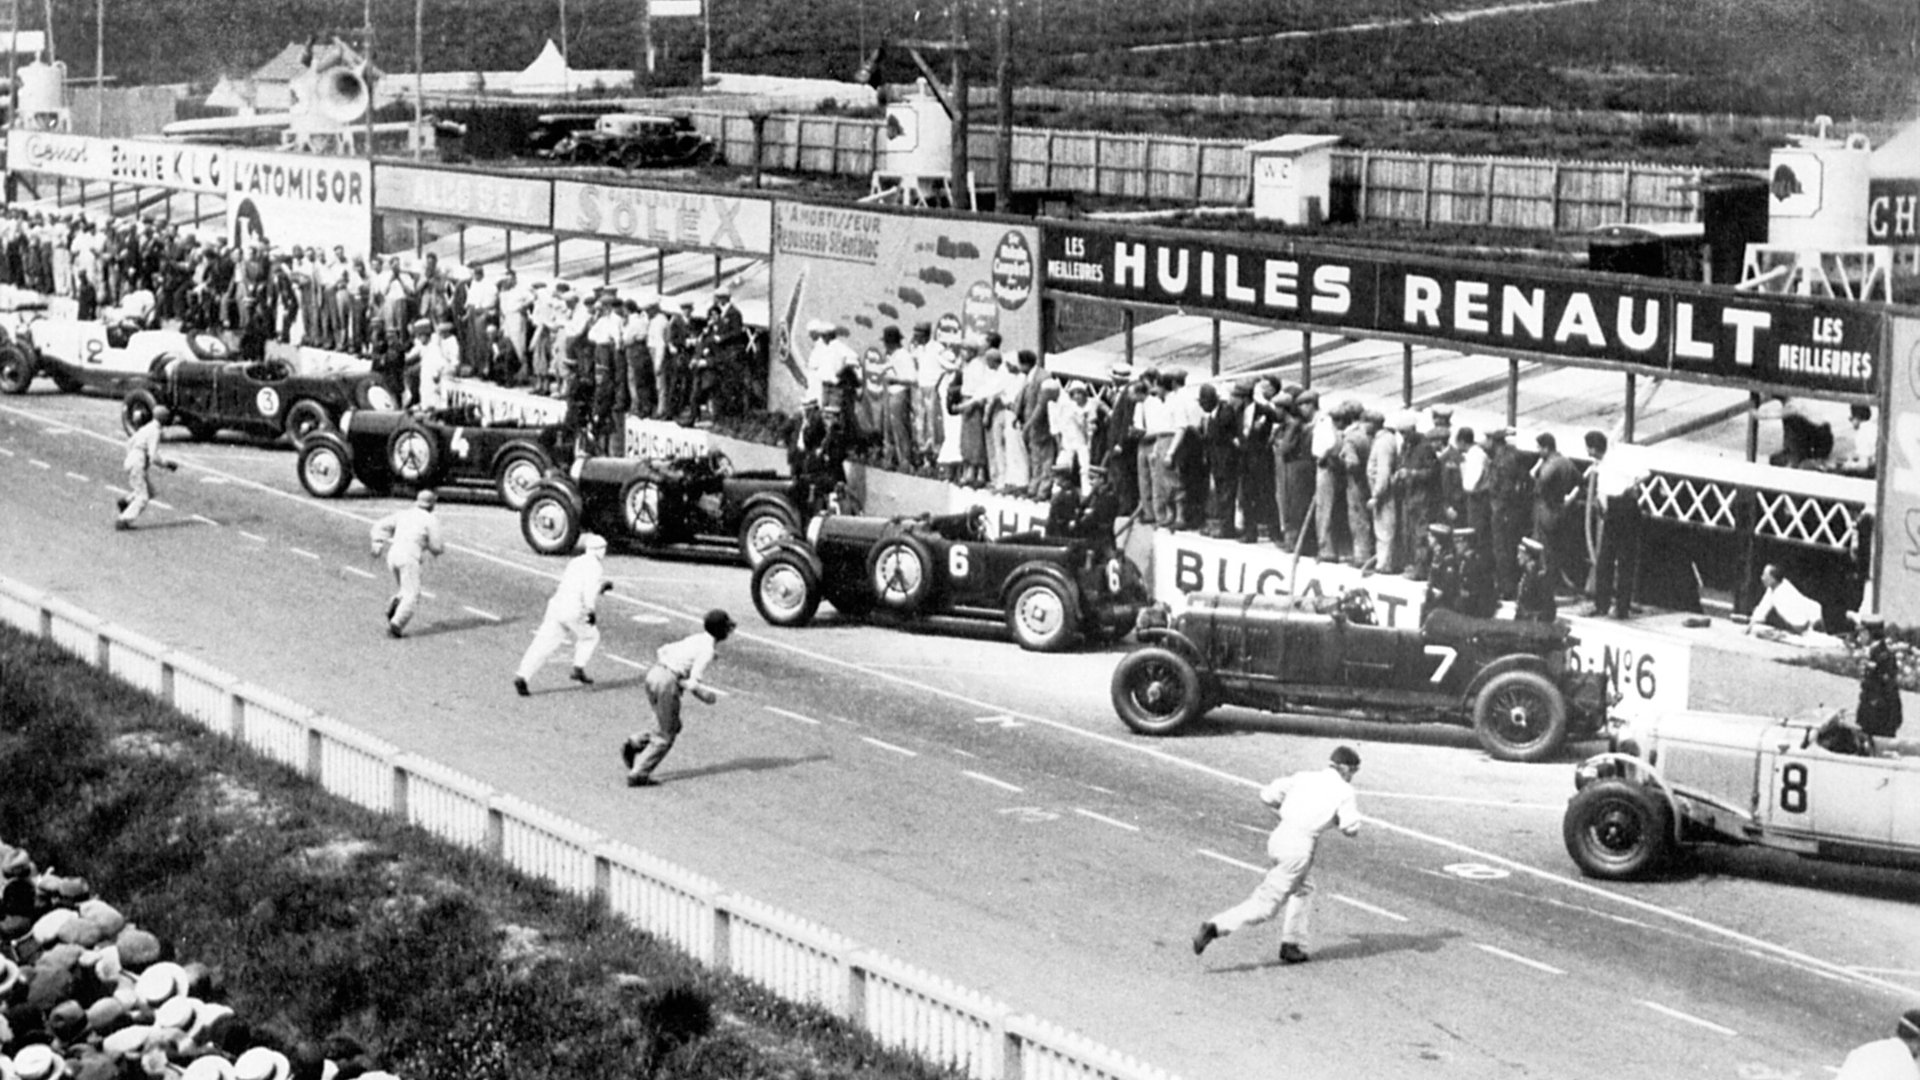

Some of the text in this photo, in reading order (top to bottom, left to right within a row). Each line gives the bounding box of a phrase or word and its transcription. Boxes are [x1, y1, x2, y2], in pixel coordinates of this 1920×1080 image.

[233, 158, 364, 205] L'ATOMISOR
[1065, 236, 1085, 258] LES
[1047, 258, 1105, 282] MEILLEURES
[1113, 241, 1772, 366] HUILES RENAULT
[1813, 316, 1844, 344] LES
[1778, 343, 1874, 379] MEILLEURES
[262, 391, 274, 411] 3
[450, 426, 470, 458] 4
[948, 544, 969, 577] 6
[1106, 558, 1121, 592] 6
[1424, 644, 1458, 683] 7
[1780, 762, 1808, 814] 8
